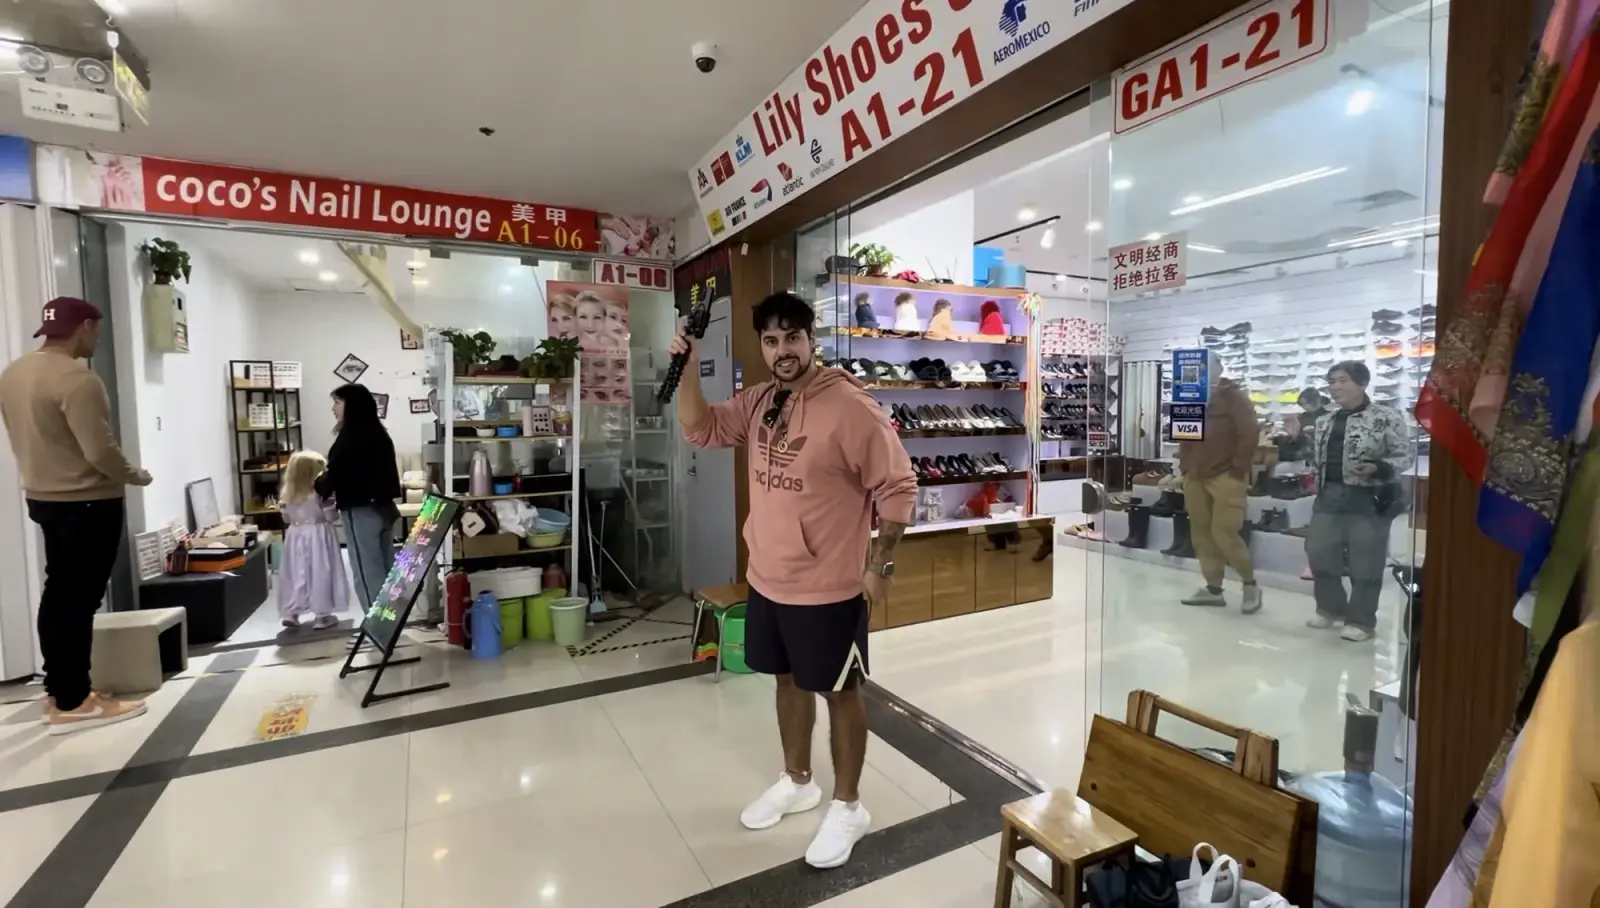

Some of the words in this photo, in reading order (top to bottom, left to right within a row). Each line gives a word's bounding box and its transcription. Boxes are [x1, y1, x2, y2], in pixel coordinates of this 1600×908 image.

[993, 21, 1051, 66] AEROMEXICO
[1121, 0, 1315, 120] GA1-21
[752, 92, 806, 157] Lily
[805, 0, 932, 116] Shoes
[841, 27, 984, 162] A1-21
[735, 141, 753, 164] KLM
[782, 176, 804, 197] atlantic
[156, 174, 277, 211] coco's
[289, 179, 361, 220] Nail
[372, 189, 492, 239] Lounge
[511, 203, 567, 227] 美甲
[724, 205, 733, 217] AIR
[731, 196, 747, 212] FRANCE
[497, 221, 583, 250] A1-06
[1113, 241, 1179, 270] 文明经商
[601, 263, 667, 288] A1-06
[1113, 263, 1179, 291] 拒绝拉客
[43, 308, 56, 321] H
[1176, 424, 1199, 433] VISA
